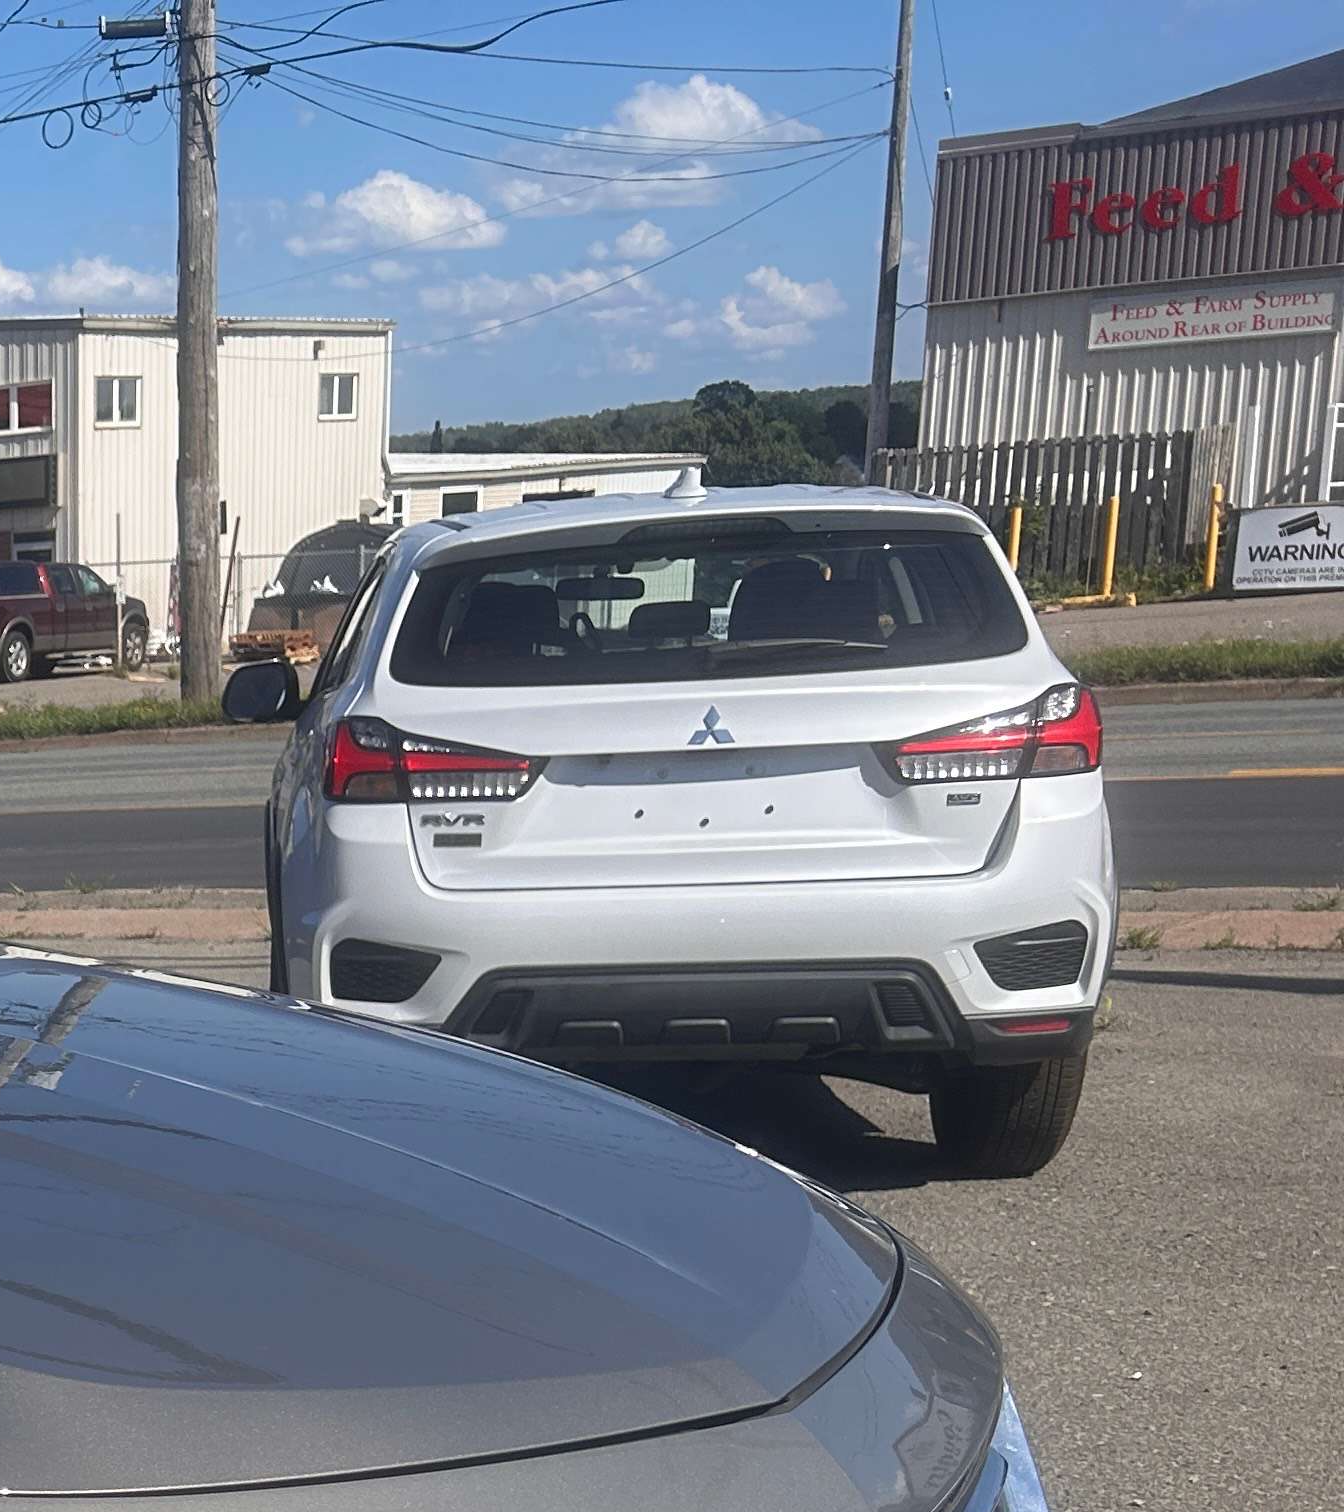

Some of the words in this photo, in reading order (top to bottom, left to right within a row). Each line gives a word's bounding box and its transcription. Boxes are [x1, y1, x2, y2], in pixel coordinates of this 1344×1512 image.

[1046, 160, 1243, 241] Feed
[1274, 151, 1344, 218] &
[1110, 303, 1158, 322] FEED
[1166, 299, 1185, 317] &
[1193, 295, 1243, 315] FARM
[1253, 290, 1323, 310] SUPPLY
[1094, 326, 1169, 345] AROUND
[1173, 320, 1221, 338] REAR
[1224, 320, 1247, 334] OF
[1251, 313, 1337, 332] BUILDING
[1276, 566, 1316, 576] CAMERAS
